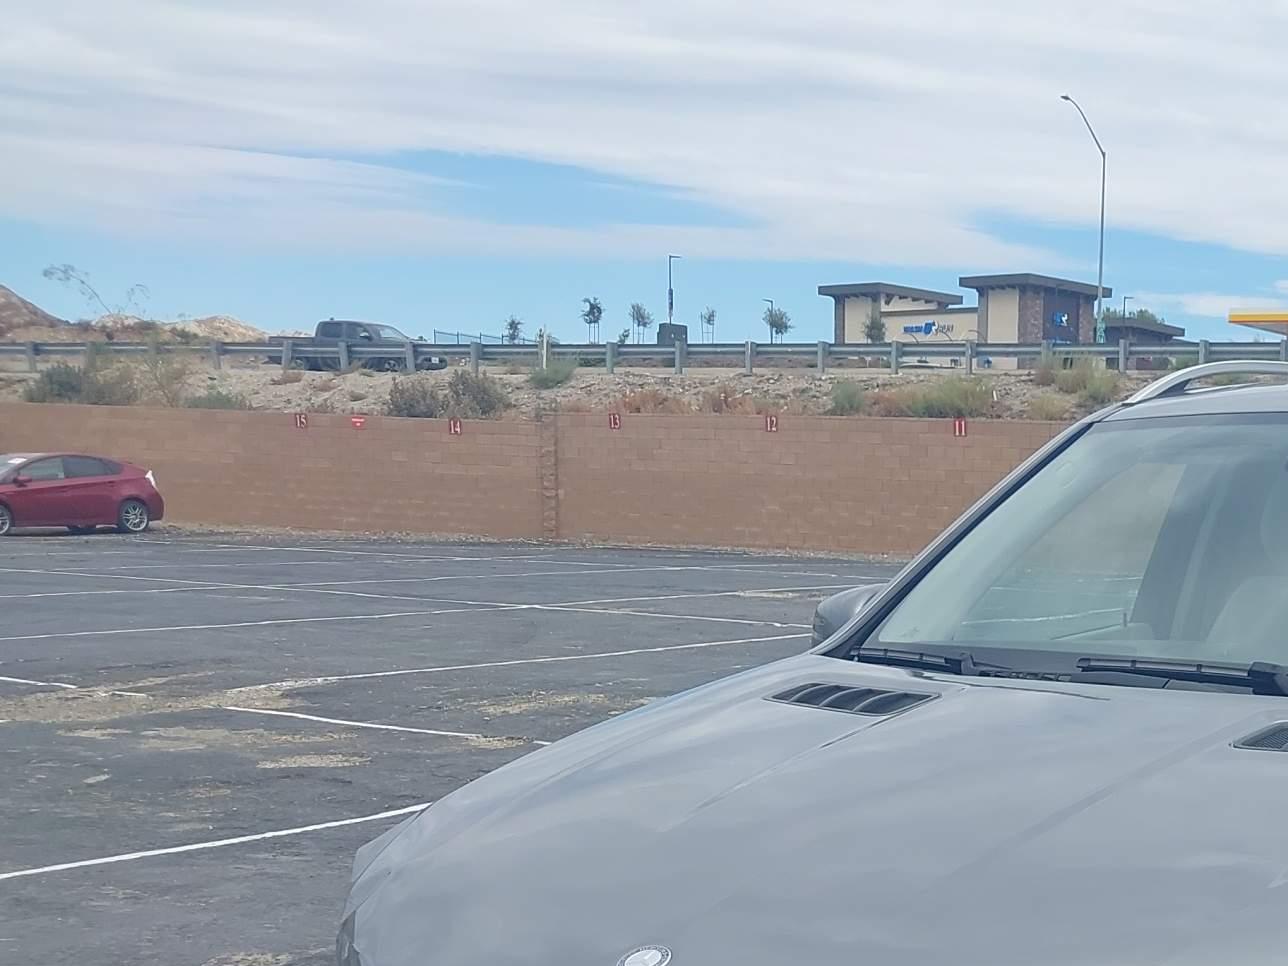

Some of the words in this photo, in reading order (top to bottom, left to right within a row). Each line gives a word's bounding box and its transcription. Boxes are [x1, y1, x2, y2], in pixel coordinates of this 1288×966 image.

[296, 414, 307, 428] 15
[450, 419, 461, 434] 14
[610, 414, 620, 428] 13
[767, 416, 777, 431] 12
[955, 420, 966, 436] 11
